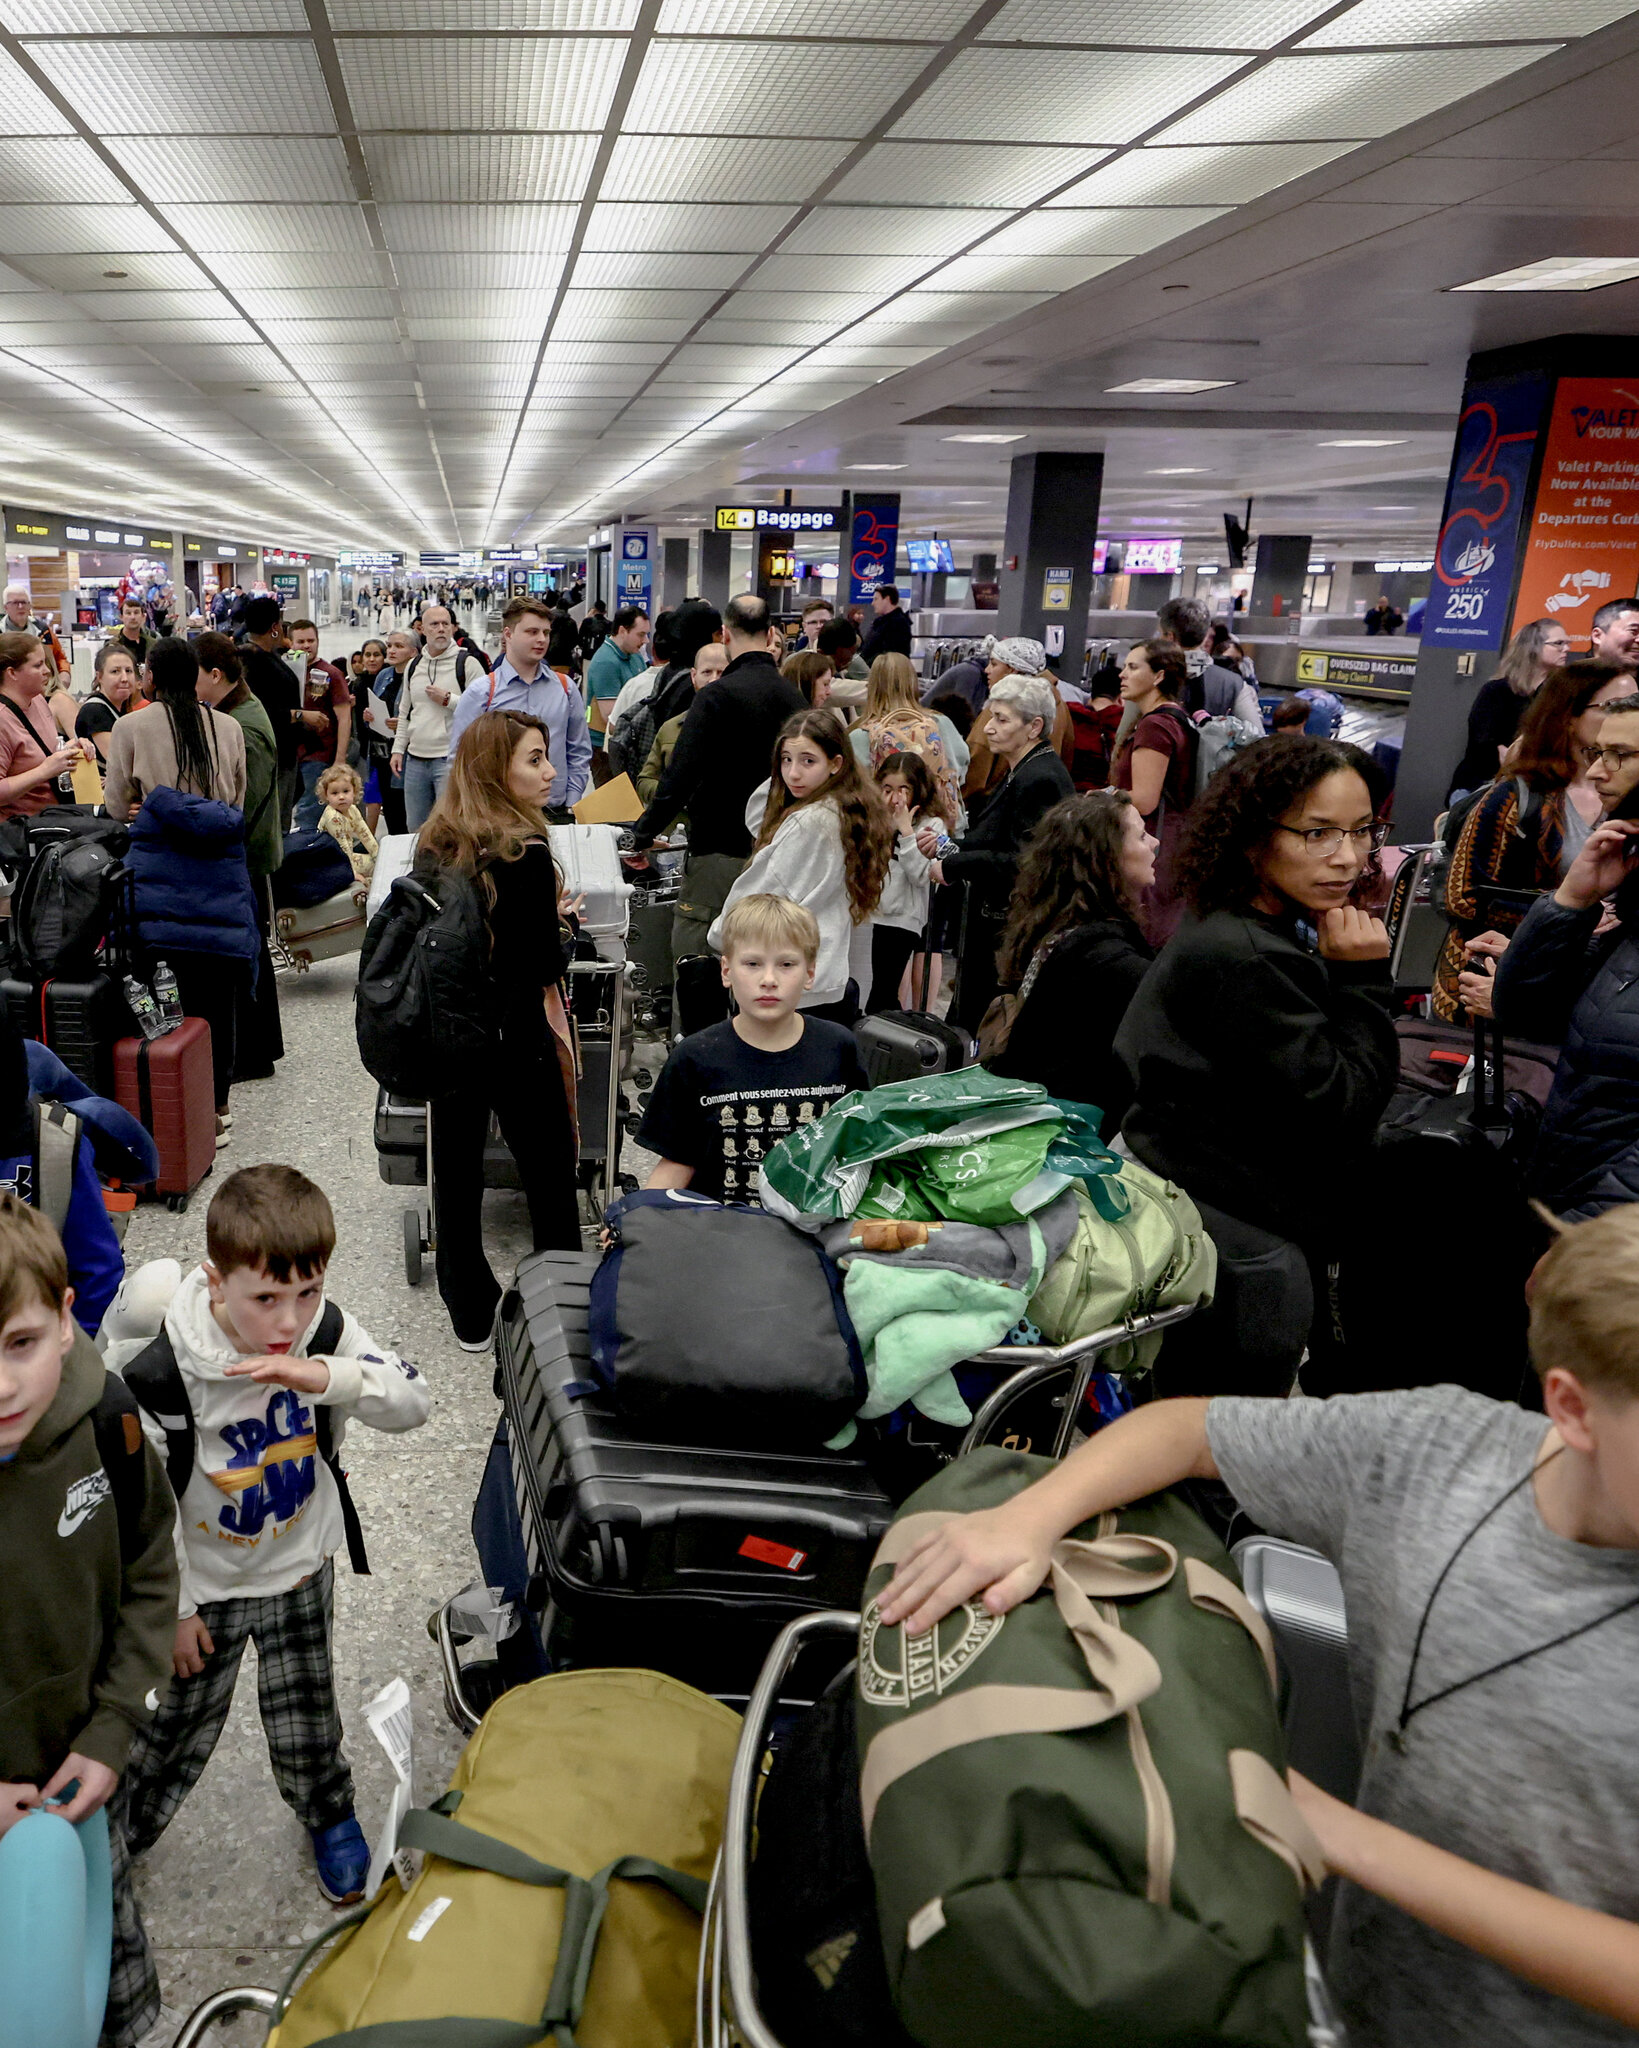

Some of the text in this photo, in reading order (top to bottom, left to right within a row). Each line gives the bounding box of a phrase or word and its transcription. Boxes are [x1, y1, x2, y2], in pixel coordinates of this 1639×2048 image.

[1588, 427, 1622, 439] YOUR
[1557, 460, 1639, 477] Valet Parking
[1550, 478, 1639, 491] Now Available
[1573, 496, 1612, 508] at the
[720, 508, 835, 530] 14 Baggage
[1537, 512, 1609, 527] Departures
[622, 563, 647, 571] Metro
[1049, 569, 1069, 578] HAND
[1444, 593, 1484, 620] 250
[1329, 658, 1416, 675] OVERSIZED BAG CLAIM
[700, 1091, 738, 1107] Comment
[739, 1089, 760, 1100] vous
[760, 1086, 810, 1098] sentez-vous
[218, 1454, 316, 1536] JAM
[196, 1520, 210, 1535] A
